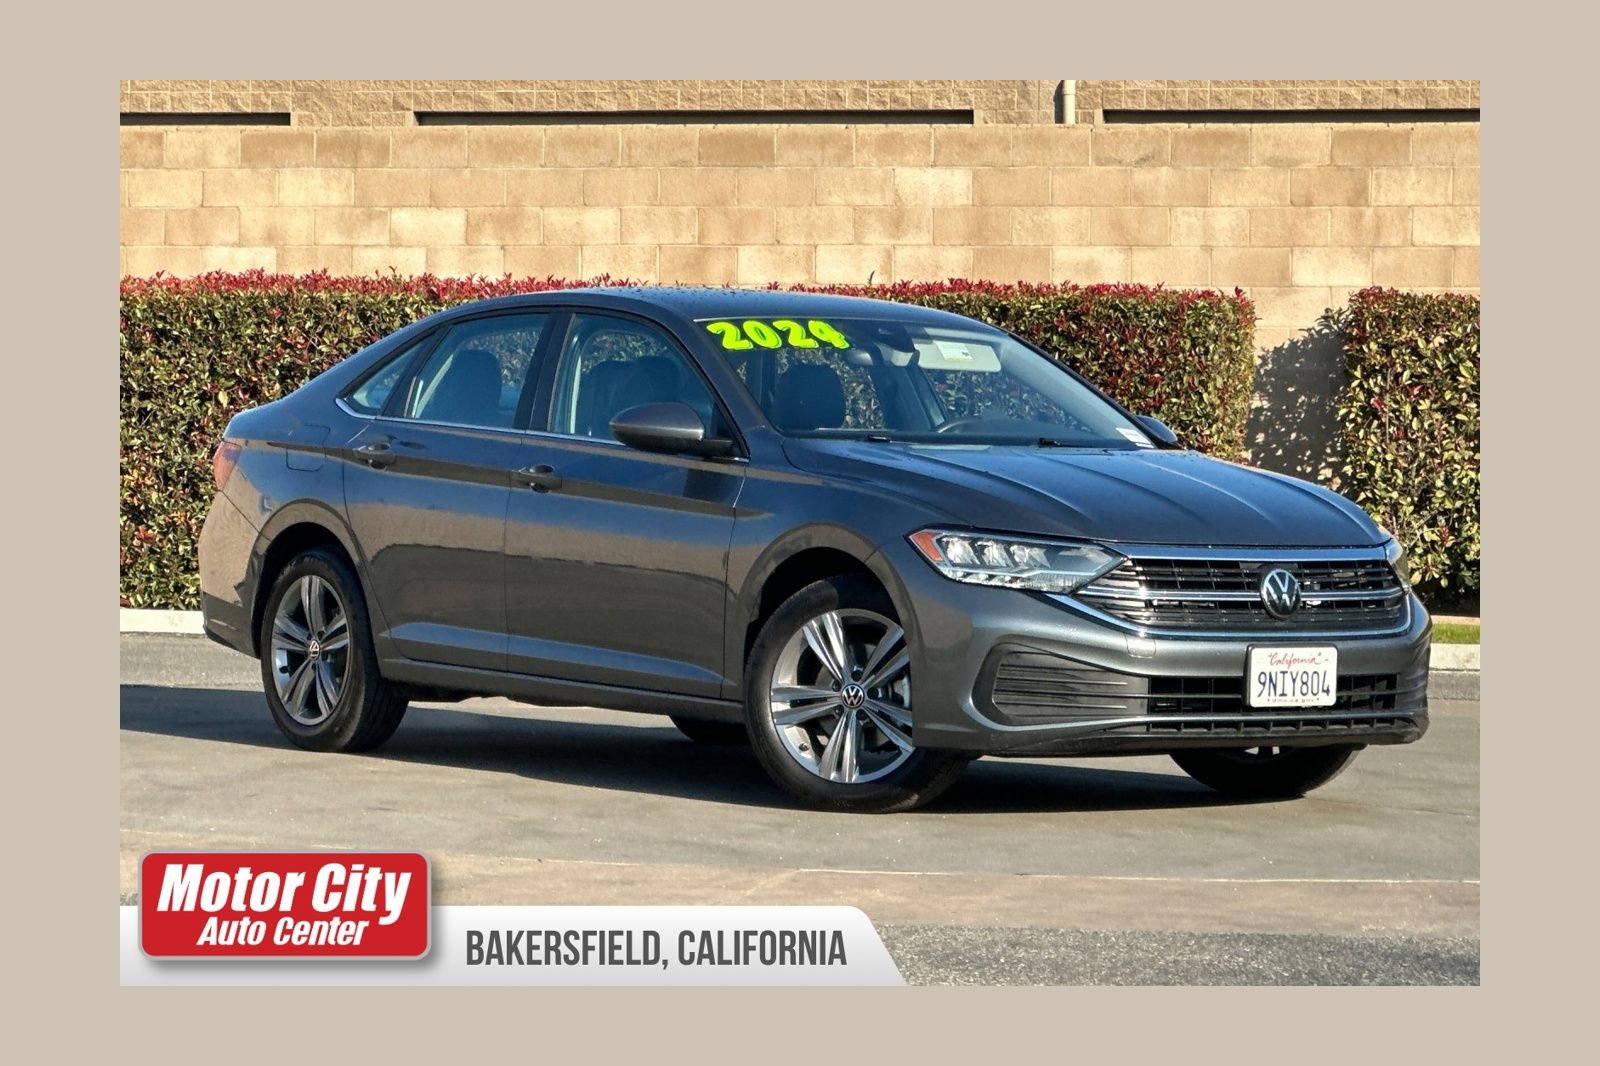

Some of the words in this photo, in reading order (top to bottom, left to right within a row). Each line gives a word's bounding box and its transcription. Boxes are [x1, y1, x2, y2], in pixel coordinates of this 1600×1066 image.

[706, 319, 850, 350] 2024
[1269, 651, 1322, 669] California
[843, 685, 864, 708] VW
[1257, 670, 1331, 698] 9NIY804
